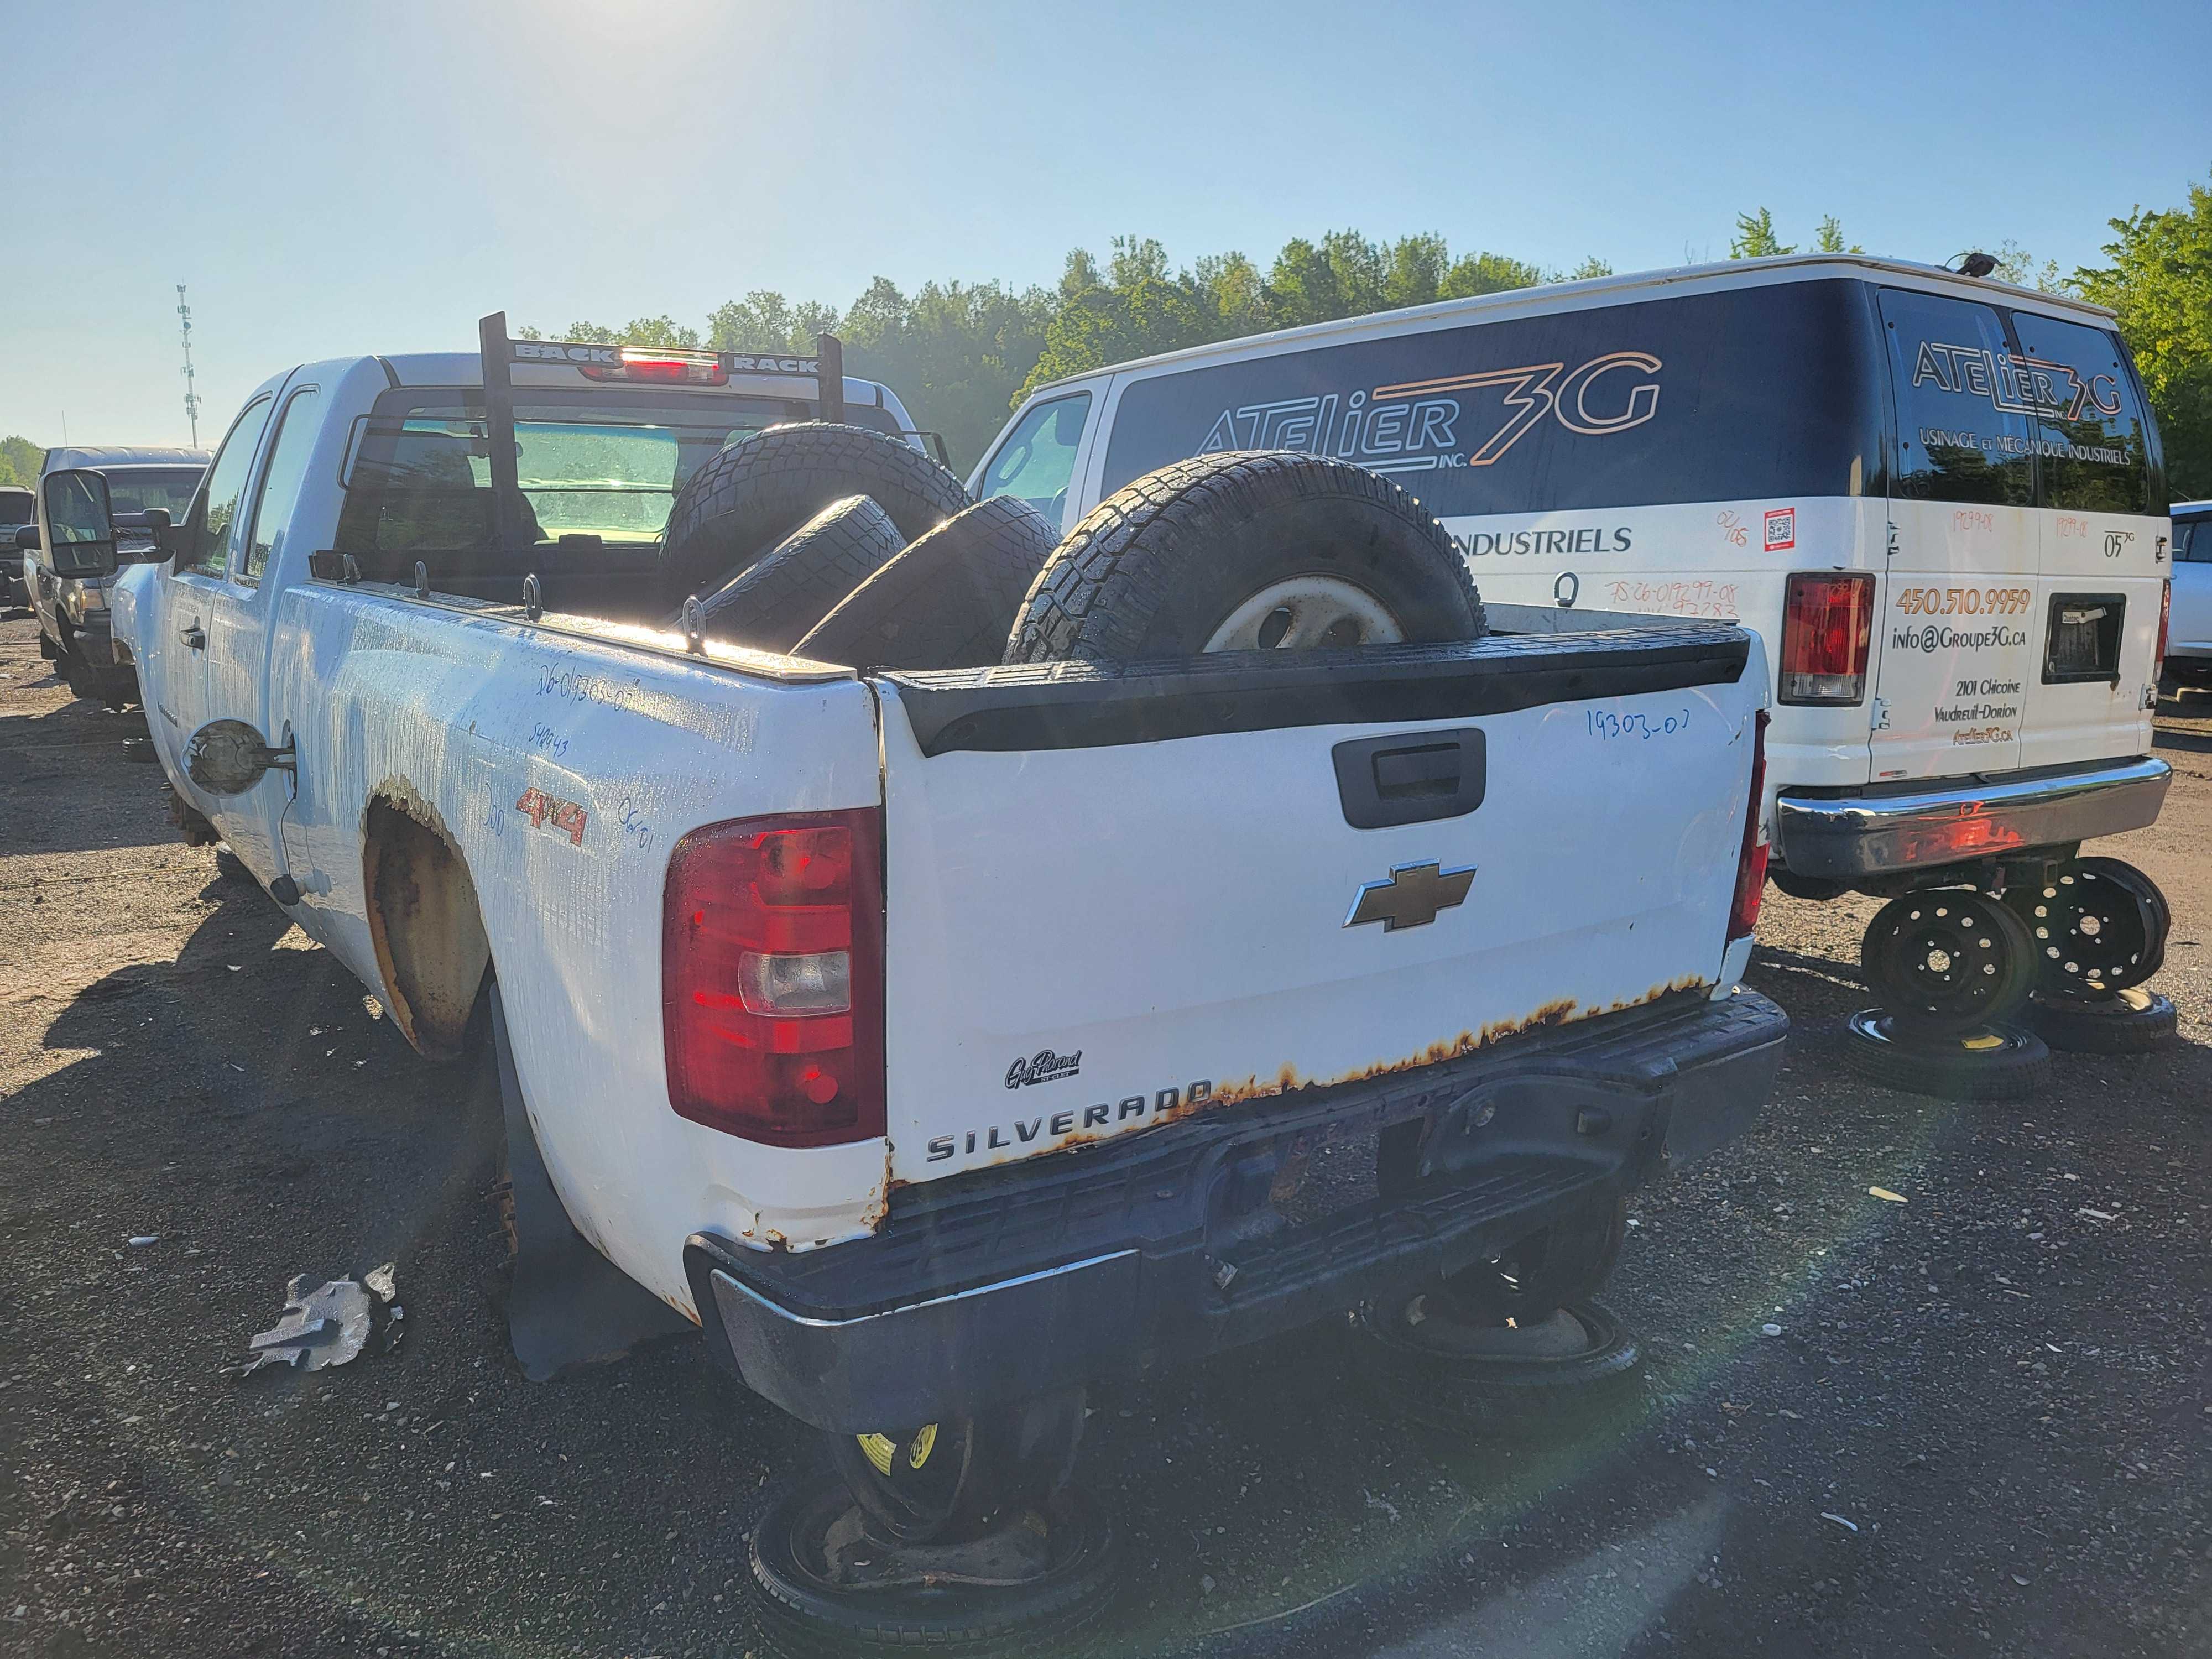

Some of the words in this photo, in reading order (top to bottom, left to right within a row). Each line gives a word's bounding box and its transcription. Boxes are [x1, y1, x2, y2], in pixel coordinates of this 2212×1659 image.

[515, 344, 615, 363] BACK
[733, 357, 821, 373] RACK
[2009, 354, 2122, 422] 3G
[1371, 351, 1662, 466] 3G
[1439, 453, 1468, 469] INC.
[1918, 427, 1978, 450] USINAGE
[1996, 433, 2065, 458] MÉCANIQUE
[2068, 443, 2131, 466] INDUSTRIELS
[1453, 526, 1632, 557] NDUSTRIELS
[1895, 588, 2031, 615] 450.510.9959
[1955, 680, 1978, 696] 2101
[926, 1079, 1212, 1162] SILVERADO
